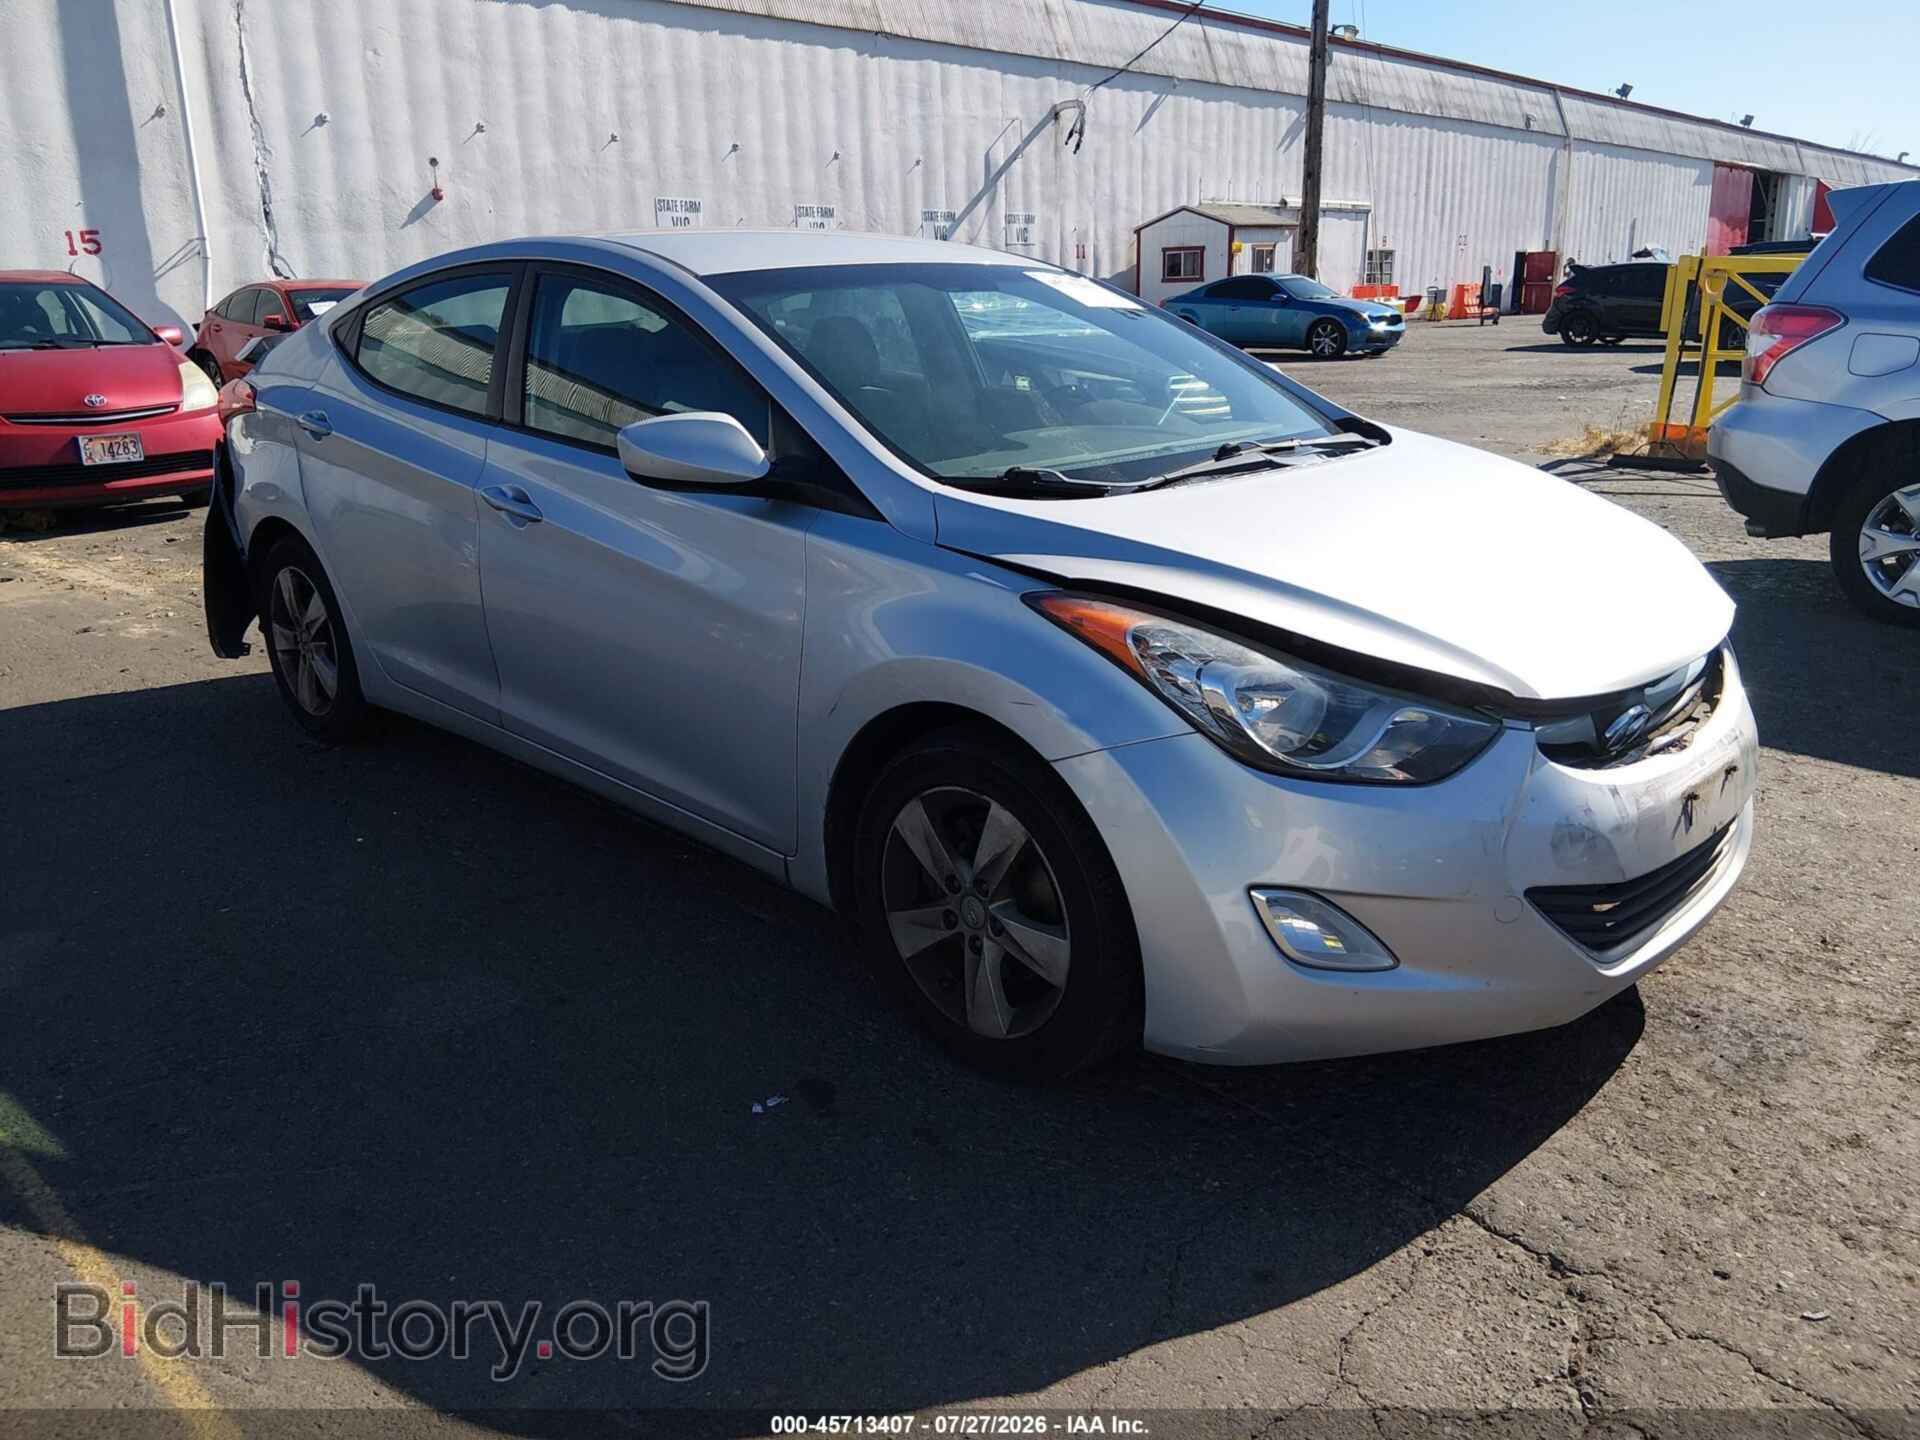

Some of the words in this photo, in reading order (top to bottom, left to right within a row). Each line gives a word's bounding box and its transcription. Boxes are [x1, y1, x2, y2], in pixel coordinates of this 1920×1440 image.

[657, 199, 679, 213] STATE
[680, 200, 701, 214] FARM
[797, 206, 815, 218] STATE
[816, 206, 835, 219] FARM
[923, 211, 940, 222] STATE
[941, 212, 956, 222] FARM
[1007, 214, 1021, 225] STATE
[1016, 227, 1029, 243] VIC
[64, 230, 103, 256] 15
[1075, 244, 1086, 259] 11
[100, 439, 138, 458] 14283
